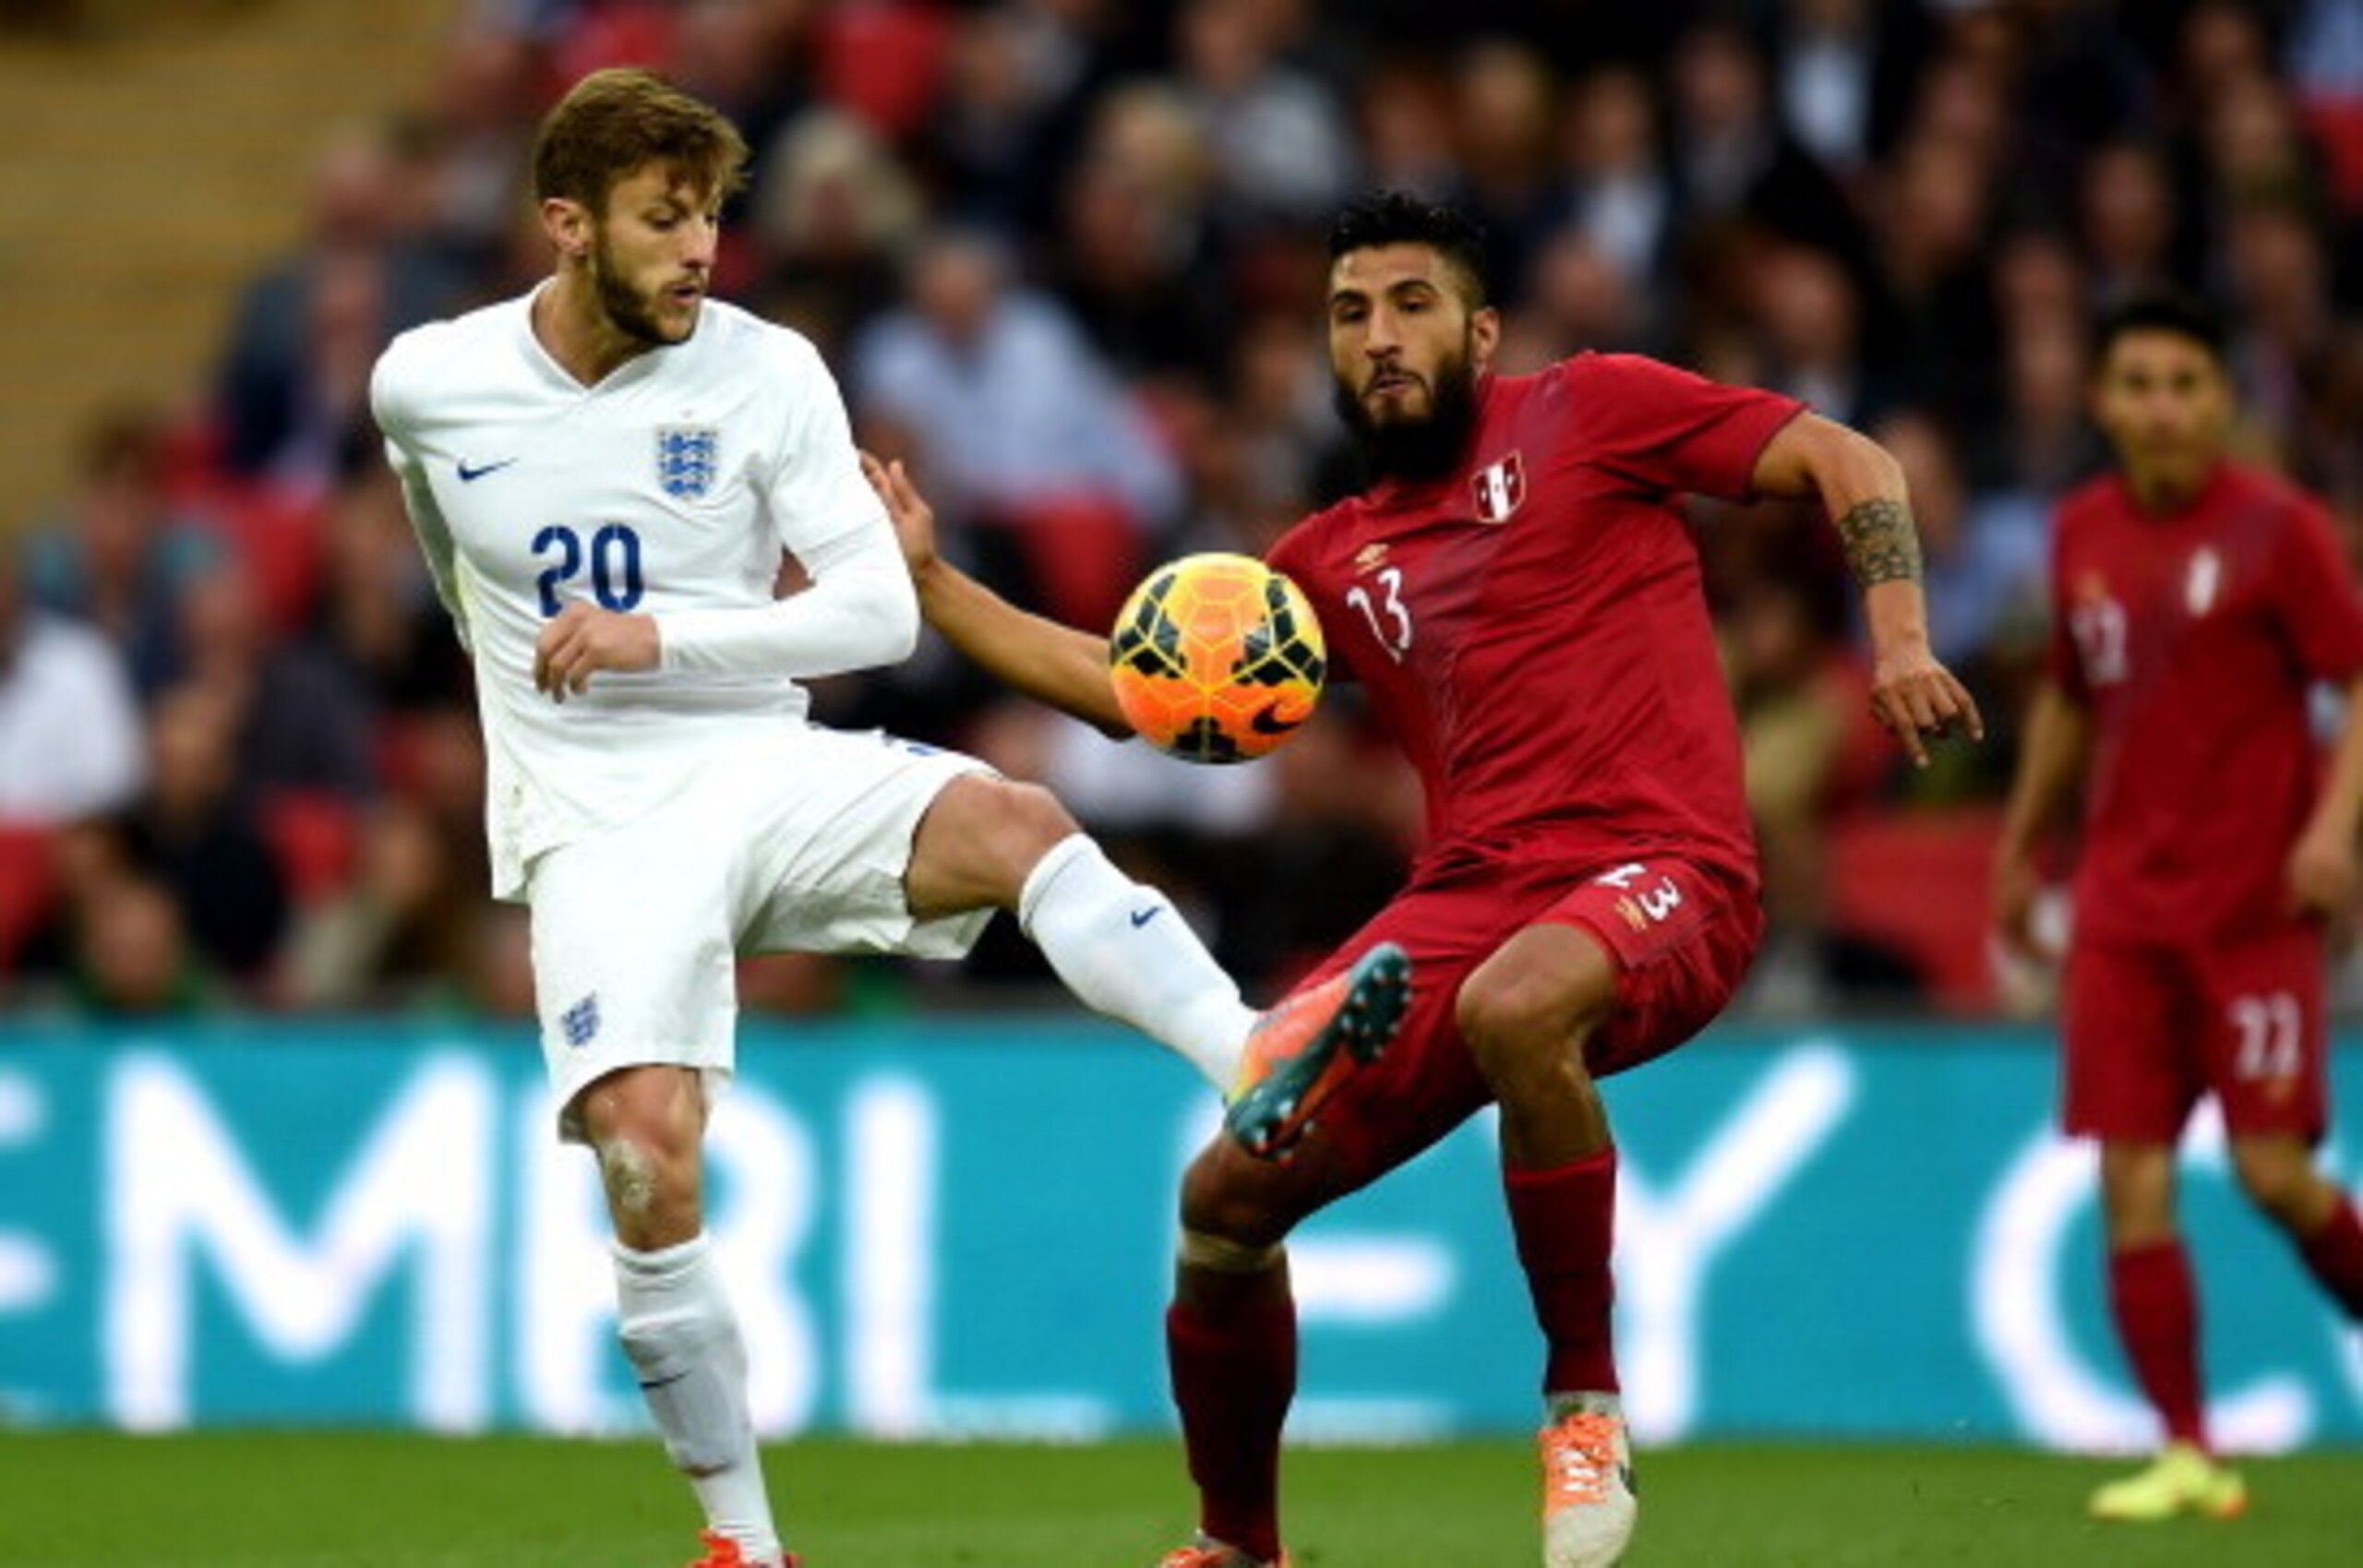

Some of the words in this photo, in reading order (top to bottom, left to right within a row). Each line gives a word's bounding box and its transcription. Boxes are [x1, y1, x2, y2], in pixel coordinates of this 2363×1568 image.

[531, 523, 644, 617] 20
[1347, 569, 1411, 665] 13
[0, 1047, 1853, 1442] MBLY
[1970, 1084, 2363, 1454] C
